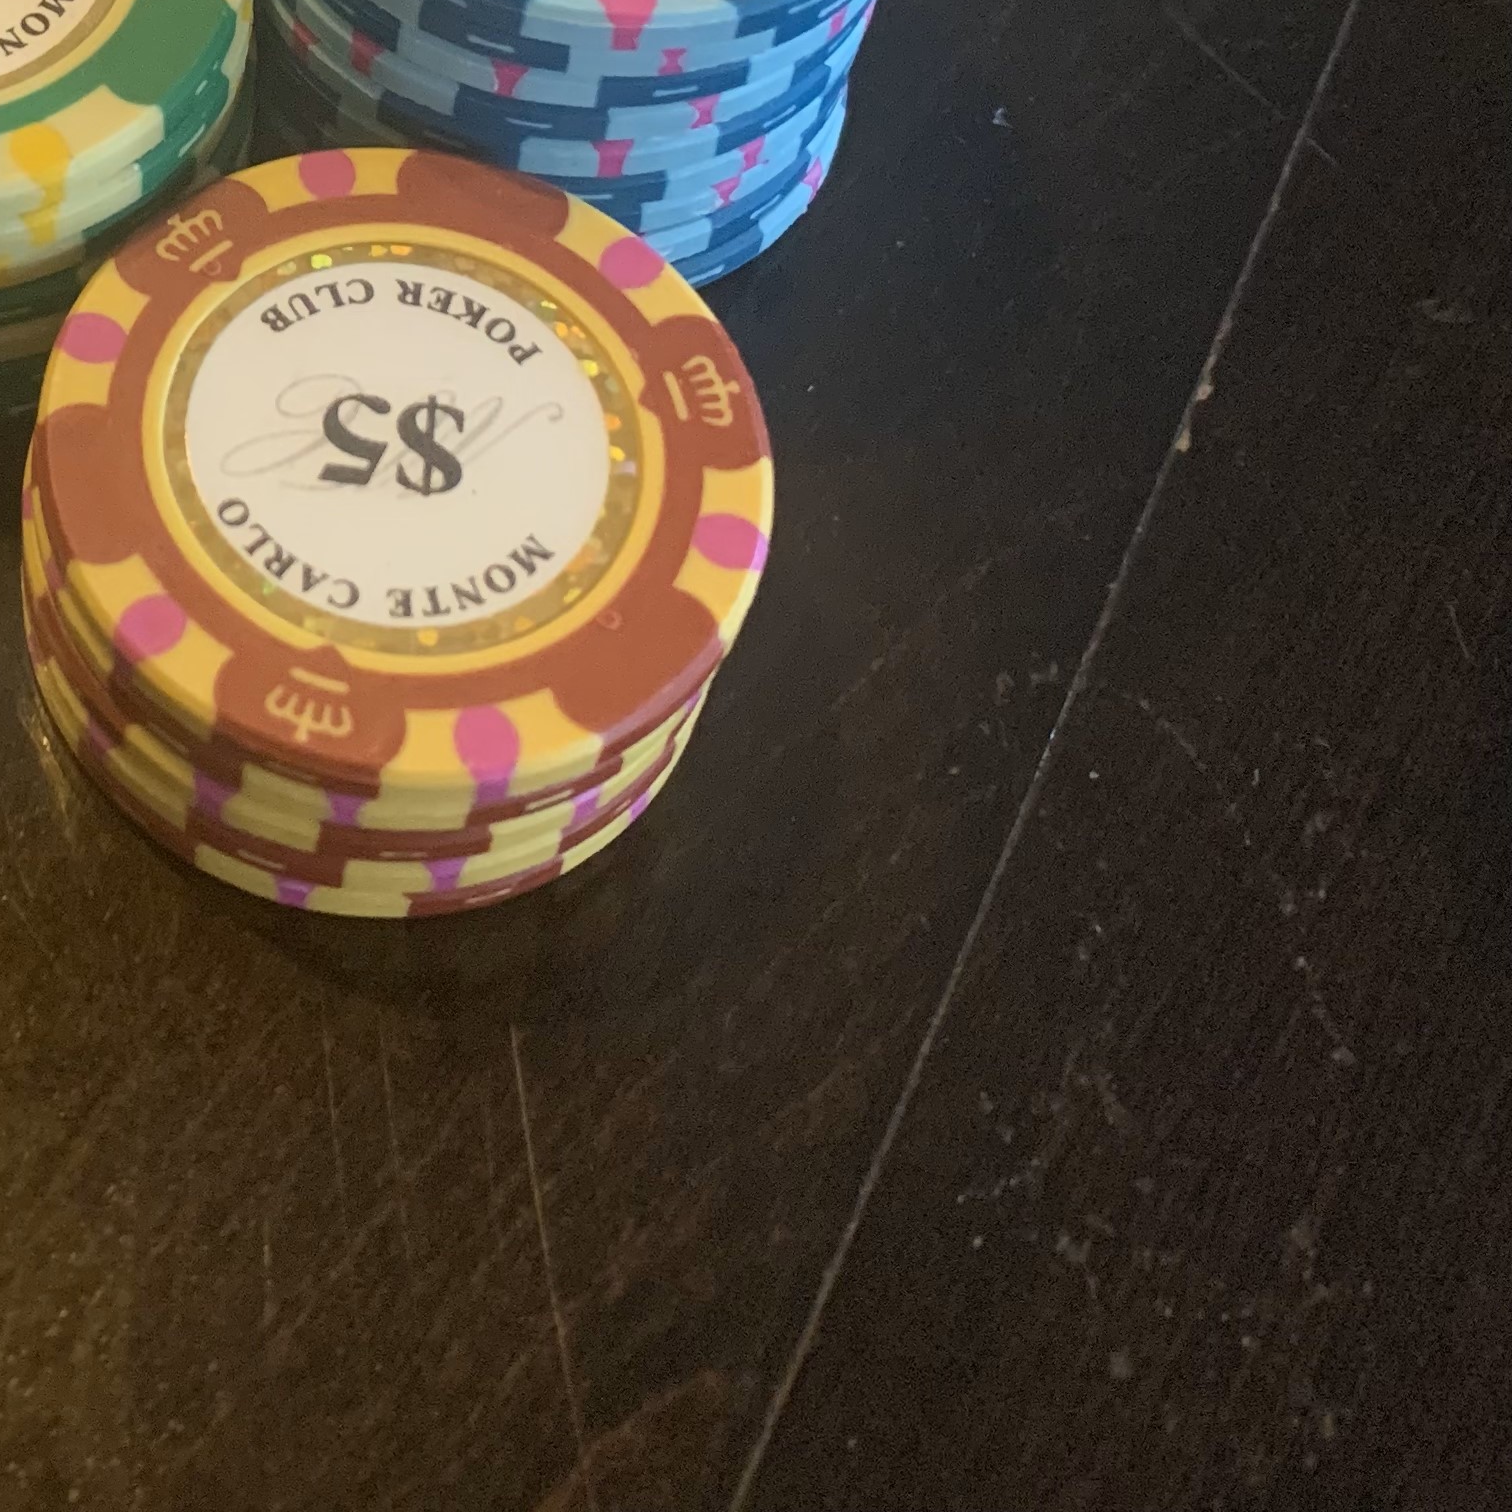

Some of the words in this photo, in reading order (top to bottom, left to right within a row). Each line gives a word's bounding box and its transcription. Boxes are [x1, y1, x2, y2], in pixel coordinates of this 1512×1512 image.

[260, 279, 374, 333] CLUB
[396, 279, 544, 366] POKER
[317, 394, 465, 496] $5
[217, 497, 361, 609] CARLO
[387, 533, 555, 617] MONTE
